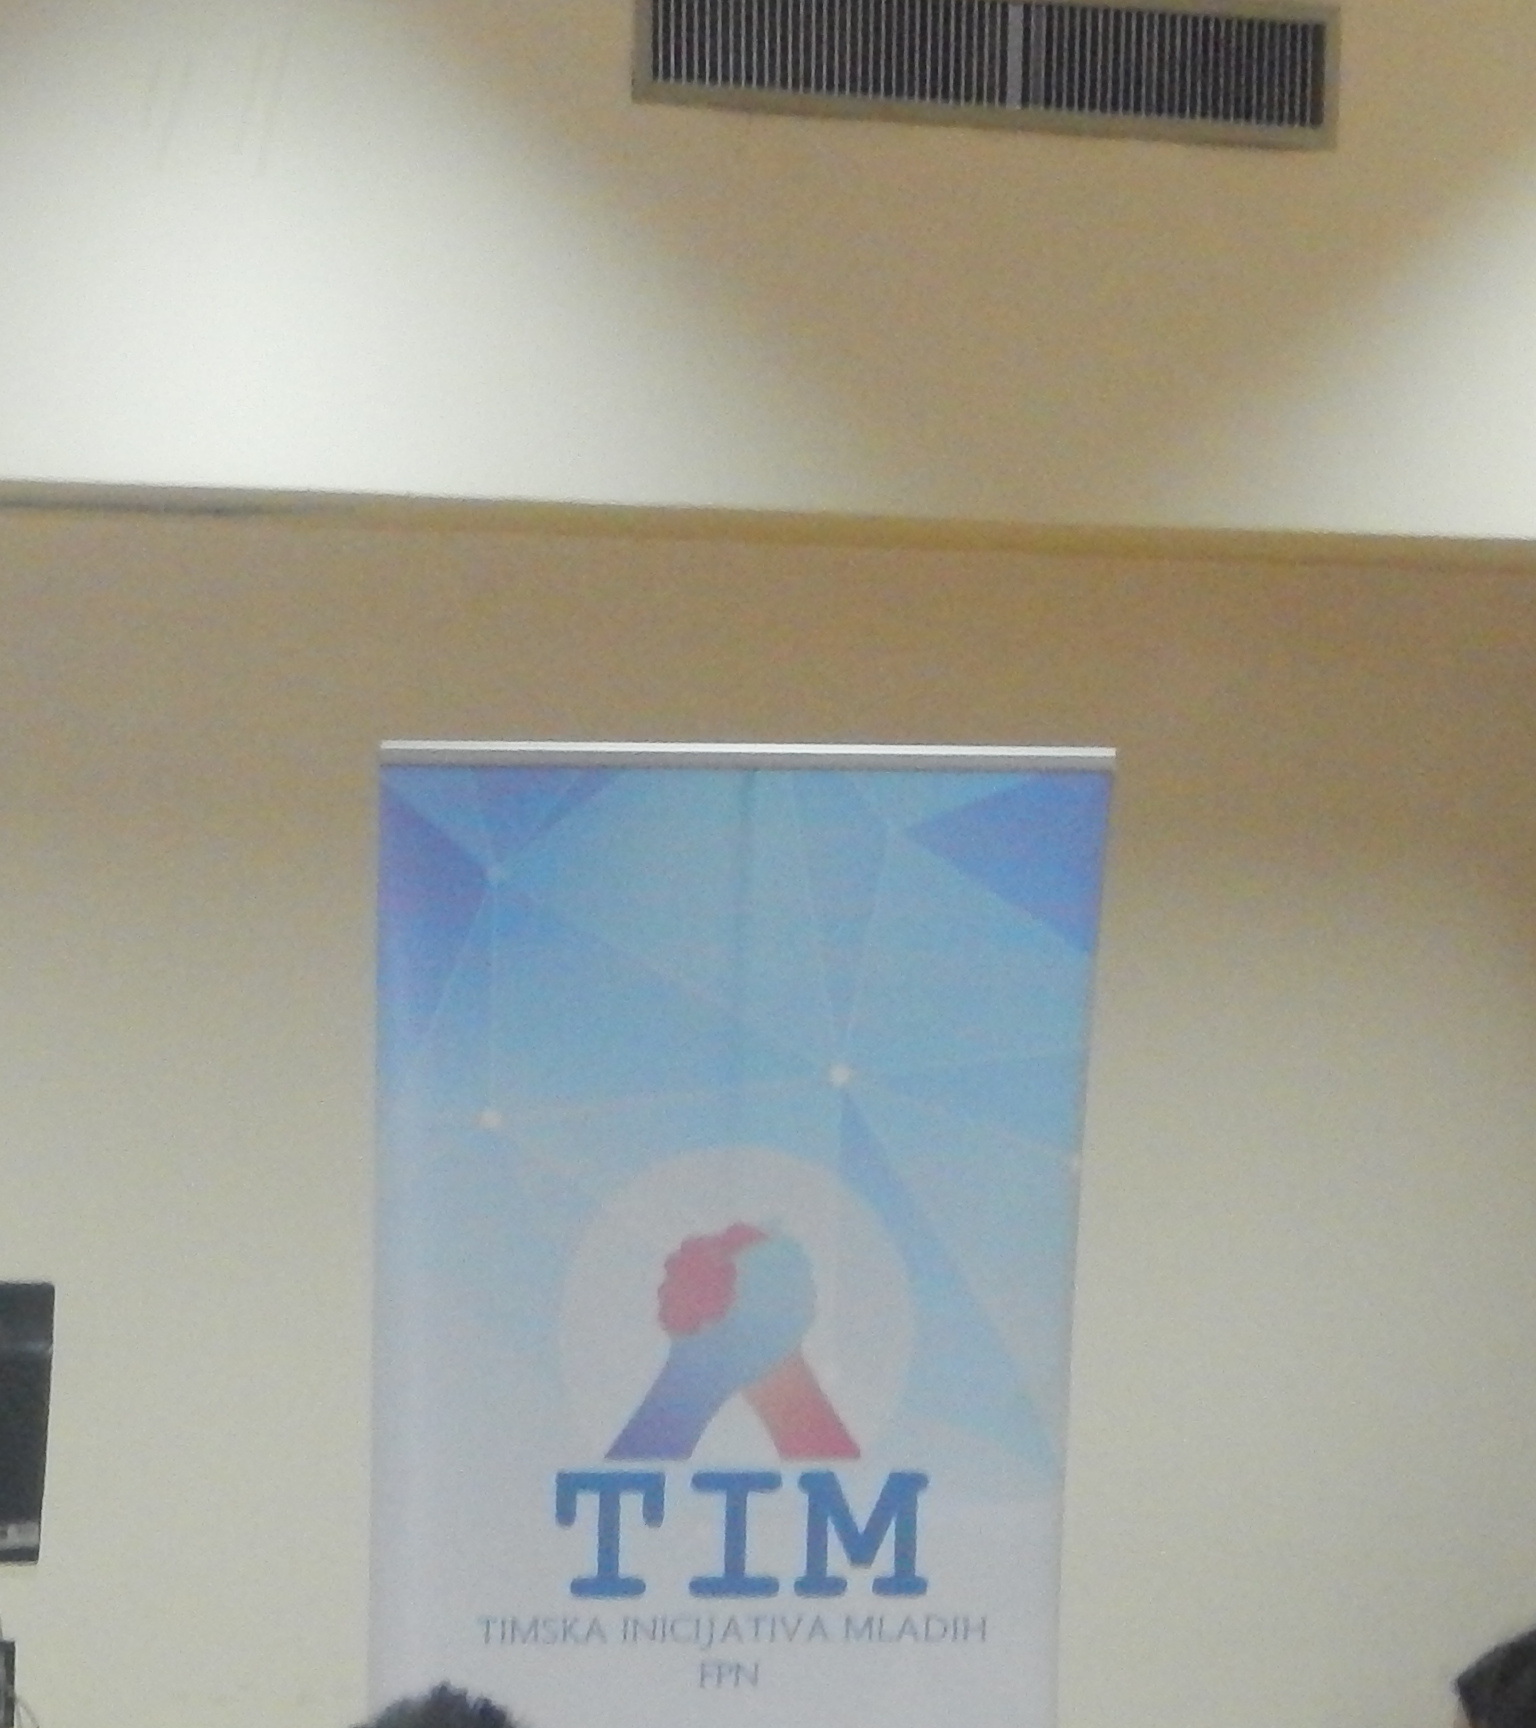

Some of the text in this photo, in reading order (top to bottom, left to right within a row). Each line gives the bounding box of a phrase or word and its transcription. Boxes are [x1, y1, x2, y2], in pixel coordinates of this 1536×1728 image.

[554, 1470, 930, 1599] TIM
[478, 1614, 988, 1651] TIMSKA INICIJATIVA MLADIH
[699, 1661, 759, 1689] FPN
